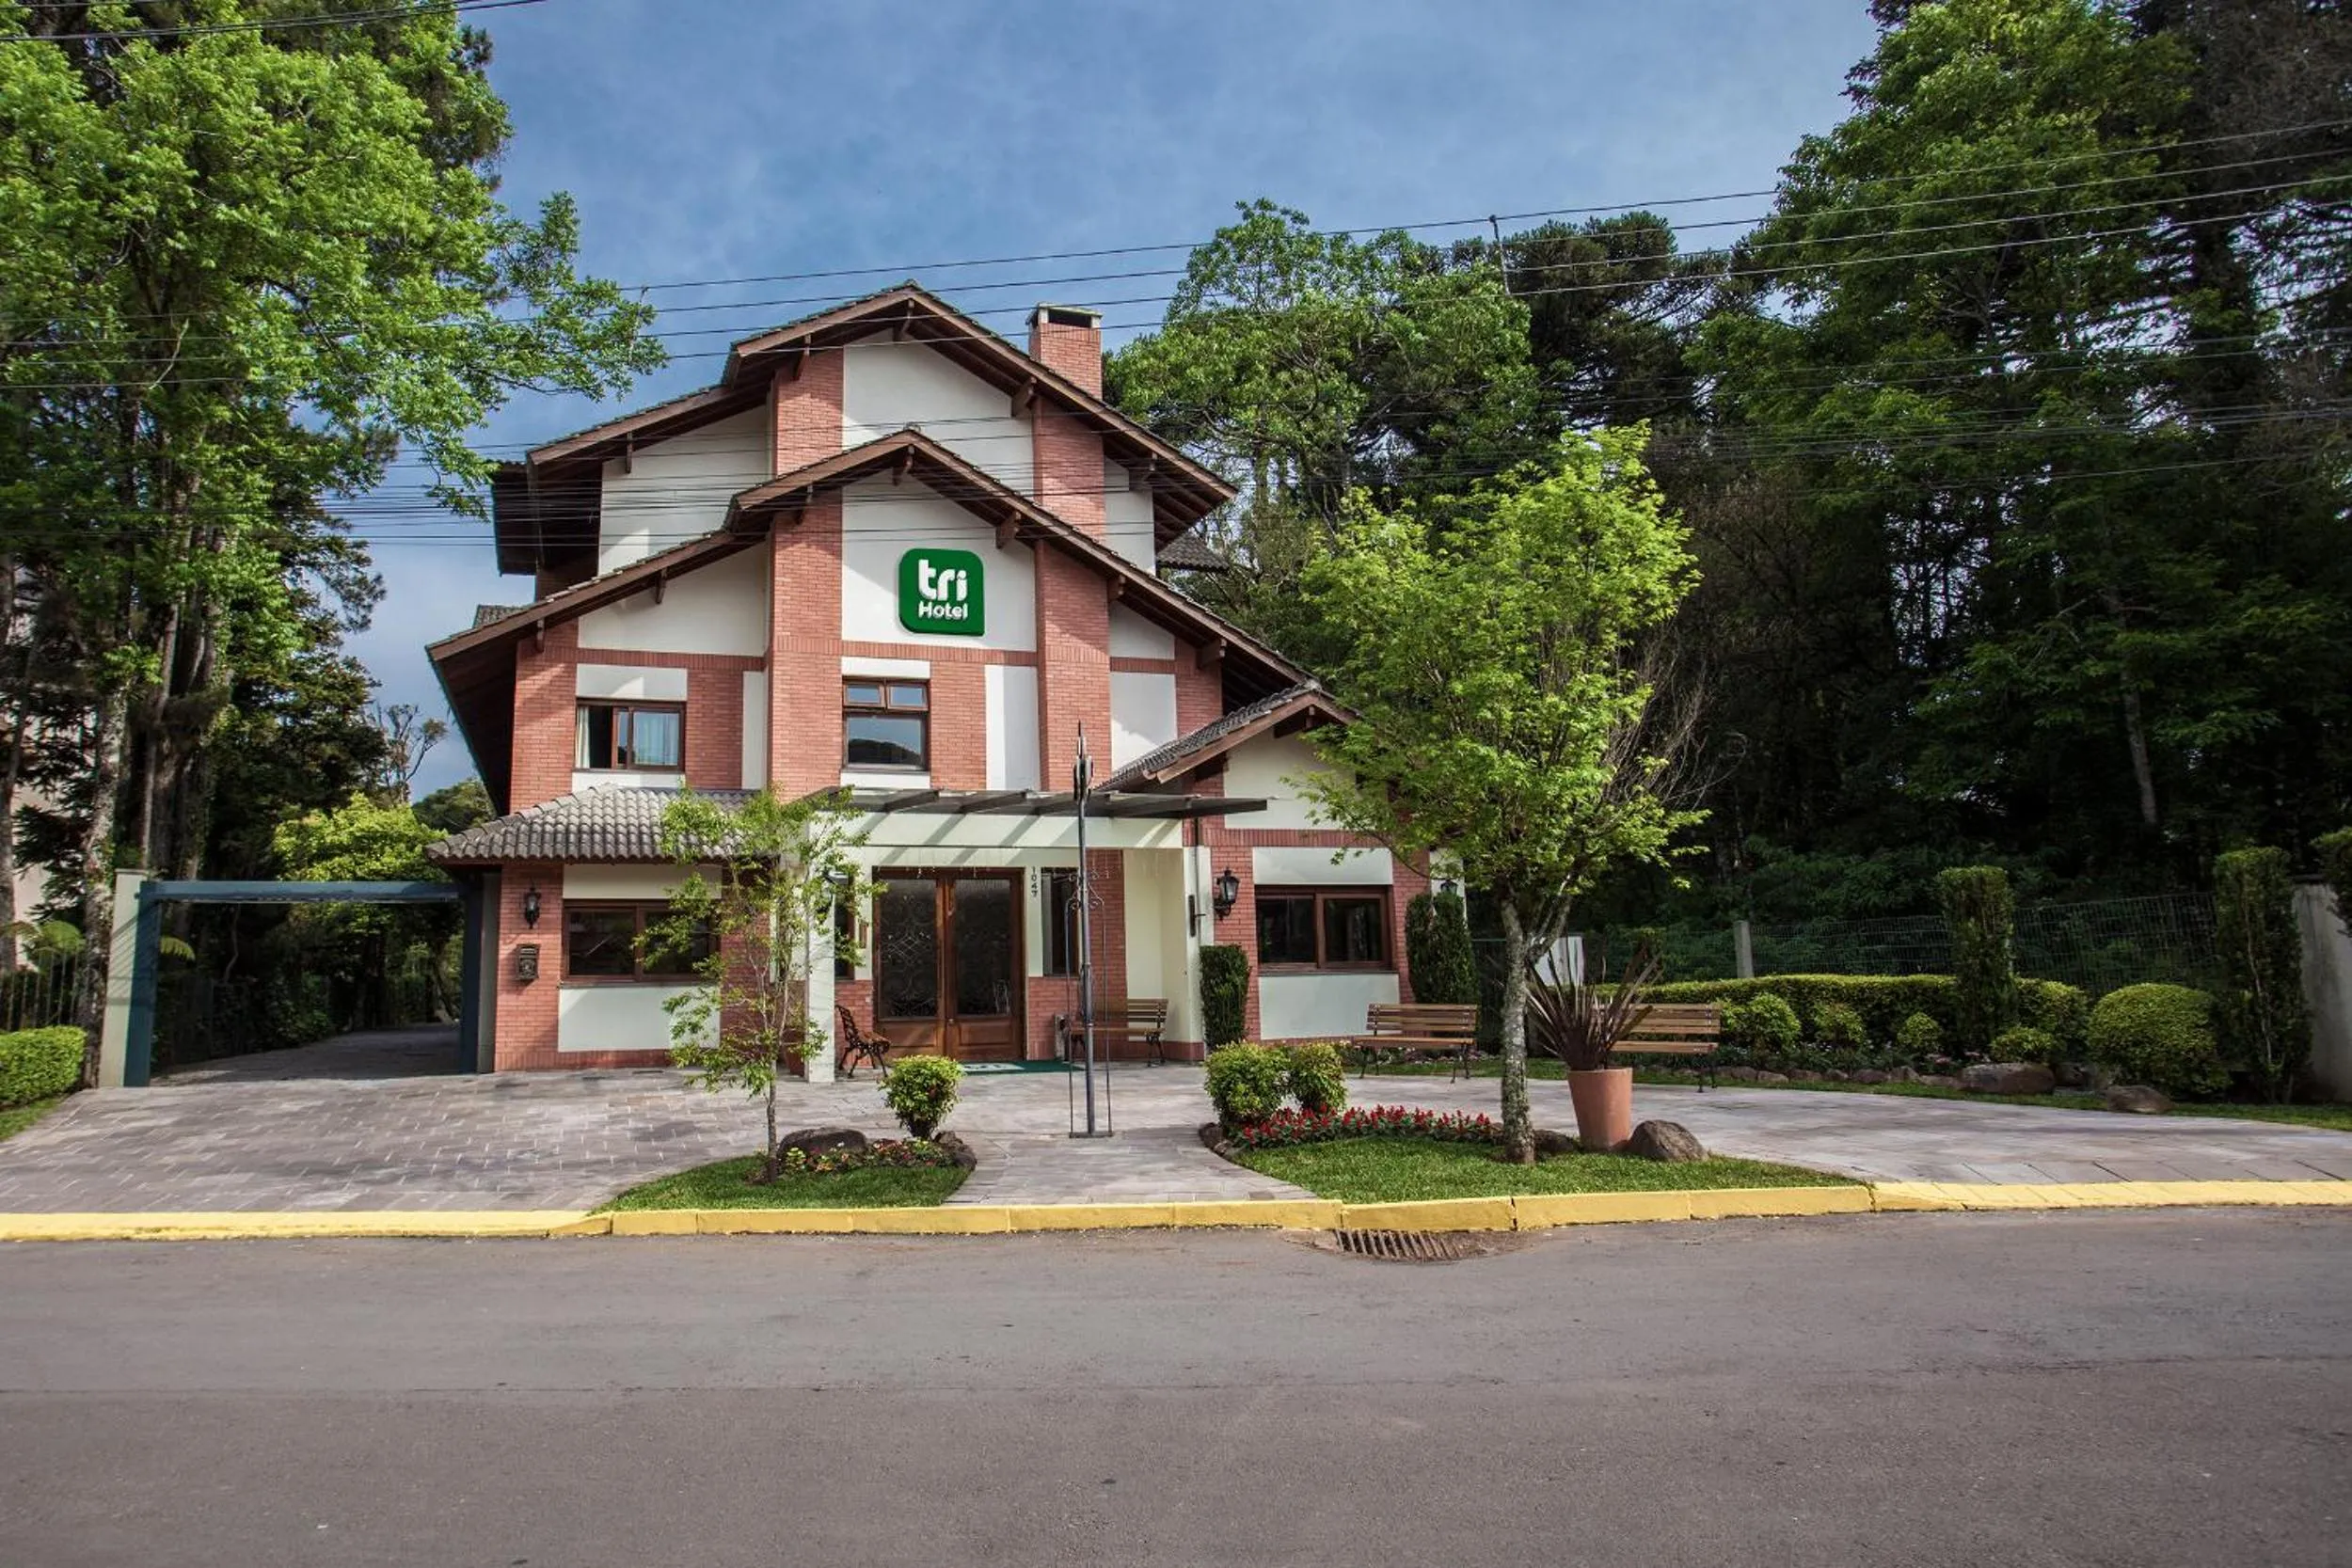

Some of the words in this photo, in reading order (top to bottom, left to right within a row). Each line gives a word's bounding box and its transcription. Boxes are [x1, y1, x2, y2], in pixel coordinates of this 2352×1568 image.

[918, 560, 967, 601] tri
[918, 601, 968, 620] Hotel
[1030, 865, 1039, 897] 1047
